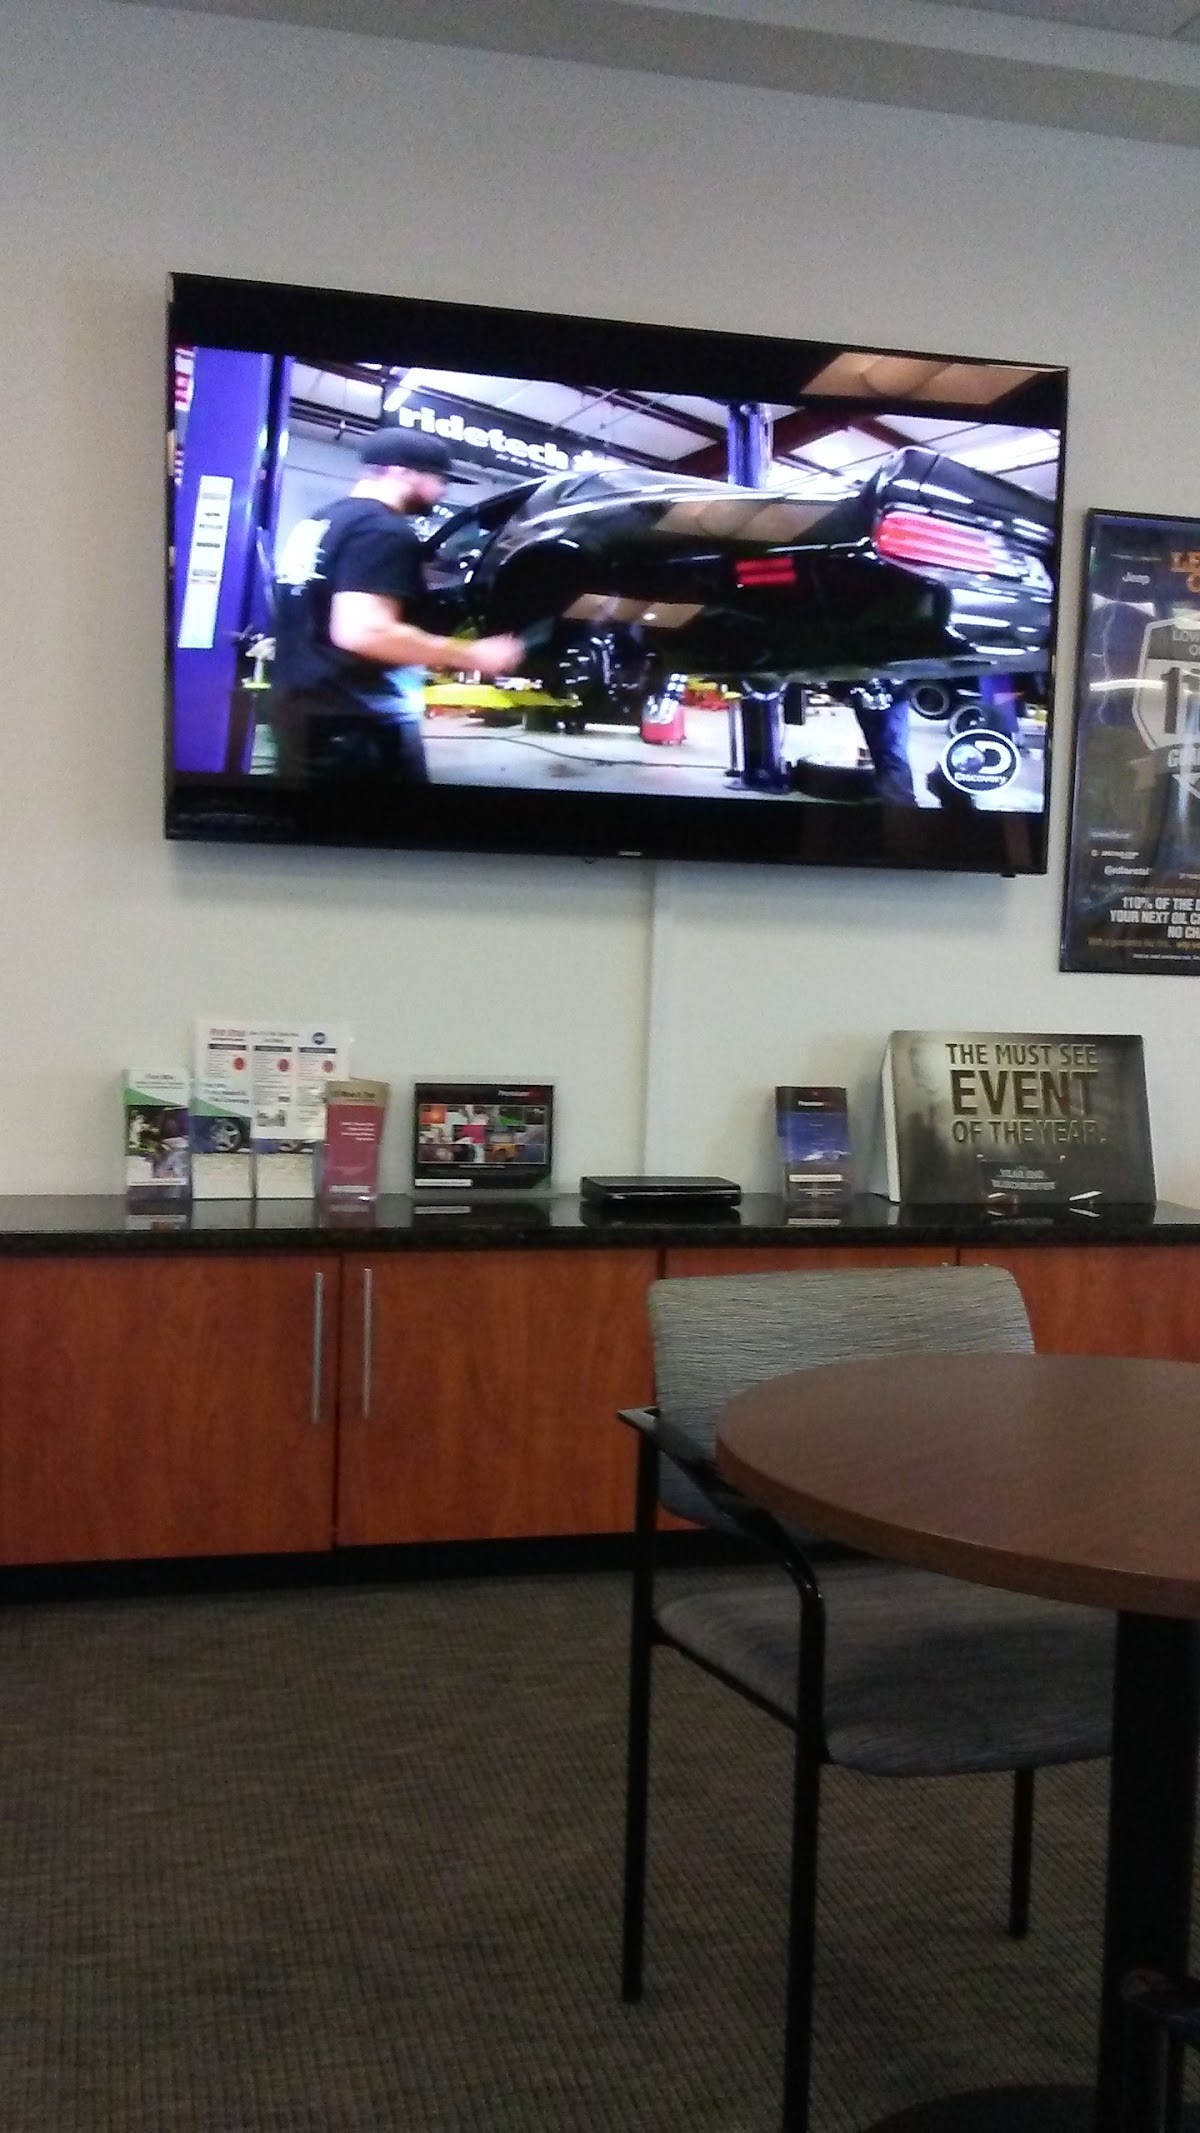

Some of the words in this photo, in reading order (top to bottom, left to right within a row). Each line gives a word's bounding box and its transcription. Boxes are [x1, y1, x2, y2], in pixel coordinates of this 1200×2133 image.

[399, 406, 569, 470] ridetech
[1122, 571, 1151, 586] Jeep
[954, 771, 1009, 786] Discovery
[1154, 897, 1171, 911] OF
[1172, 898, 1195, 912] THE
[1109, 909, 1140, 923] YOUR
[1141, 911, 1170, 924] NEXT
[1171, 912, 1188, 925] OIL
[1167, 925, 1184, 939] NO
[945, 1042, 988, 1065] THE
[995, 1043, 1052, 1066] MUST
[1059, 1043, 1099, 1066] SEE
[949, 1067, 1099, 1117] EVENT
[951, 1119, 984, 1145] OF
[987, 1119, 1035, 1145] THE
